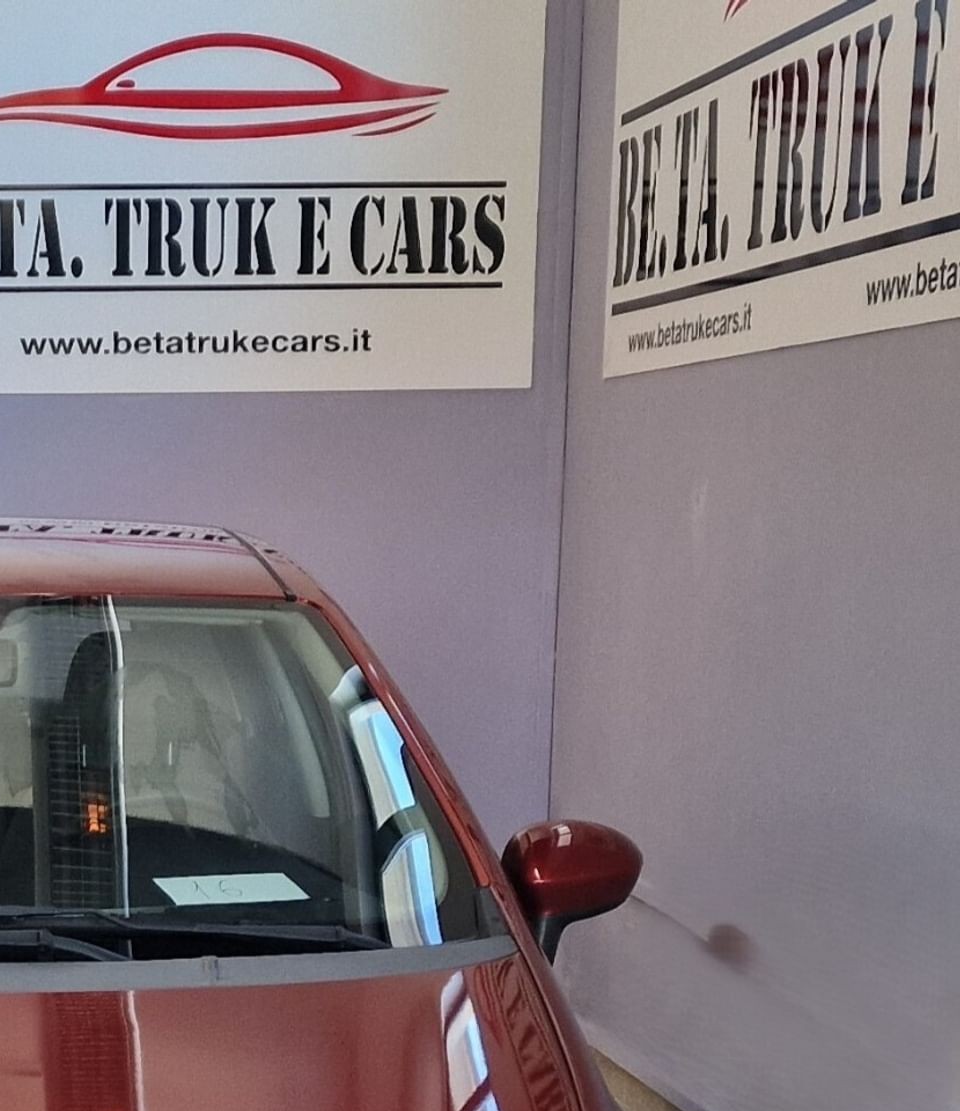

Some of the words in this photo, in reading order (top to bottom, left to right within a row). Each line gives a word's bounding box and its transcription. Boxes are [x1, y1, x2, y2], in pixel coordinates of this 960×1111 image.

[612, 98, 730, 288] BE.TA.
[747, 15, 894, 250] TRUK
[901, 0, 948, 205] E
[105, 197, 276, 278] TRUK
[297, 196, 331, 276] E
[349, 194, 506, 276] CARS
[866, 257, 960, 306] www.beta
[20, 327, 372, 356] www.betatrukecars.it
[628, 302, 752, 353] www.betatrukecars.it
